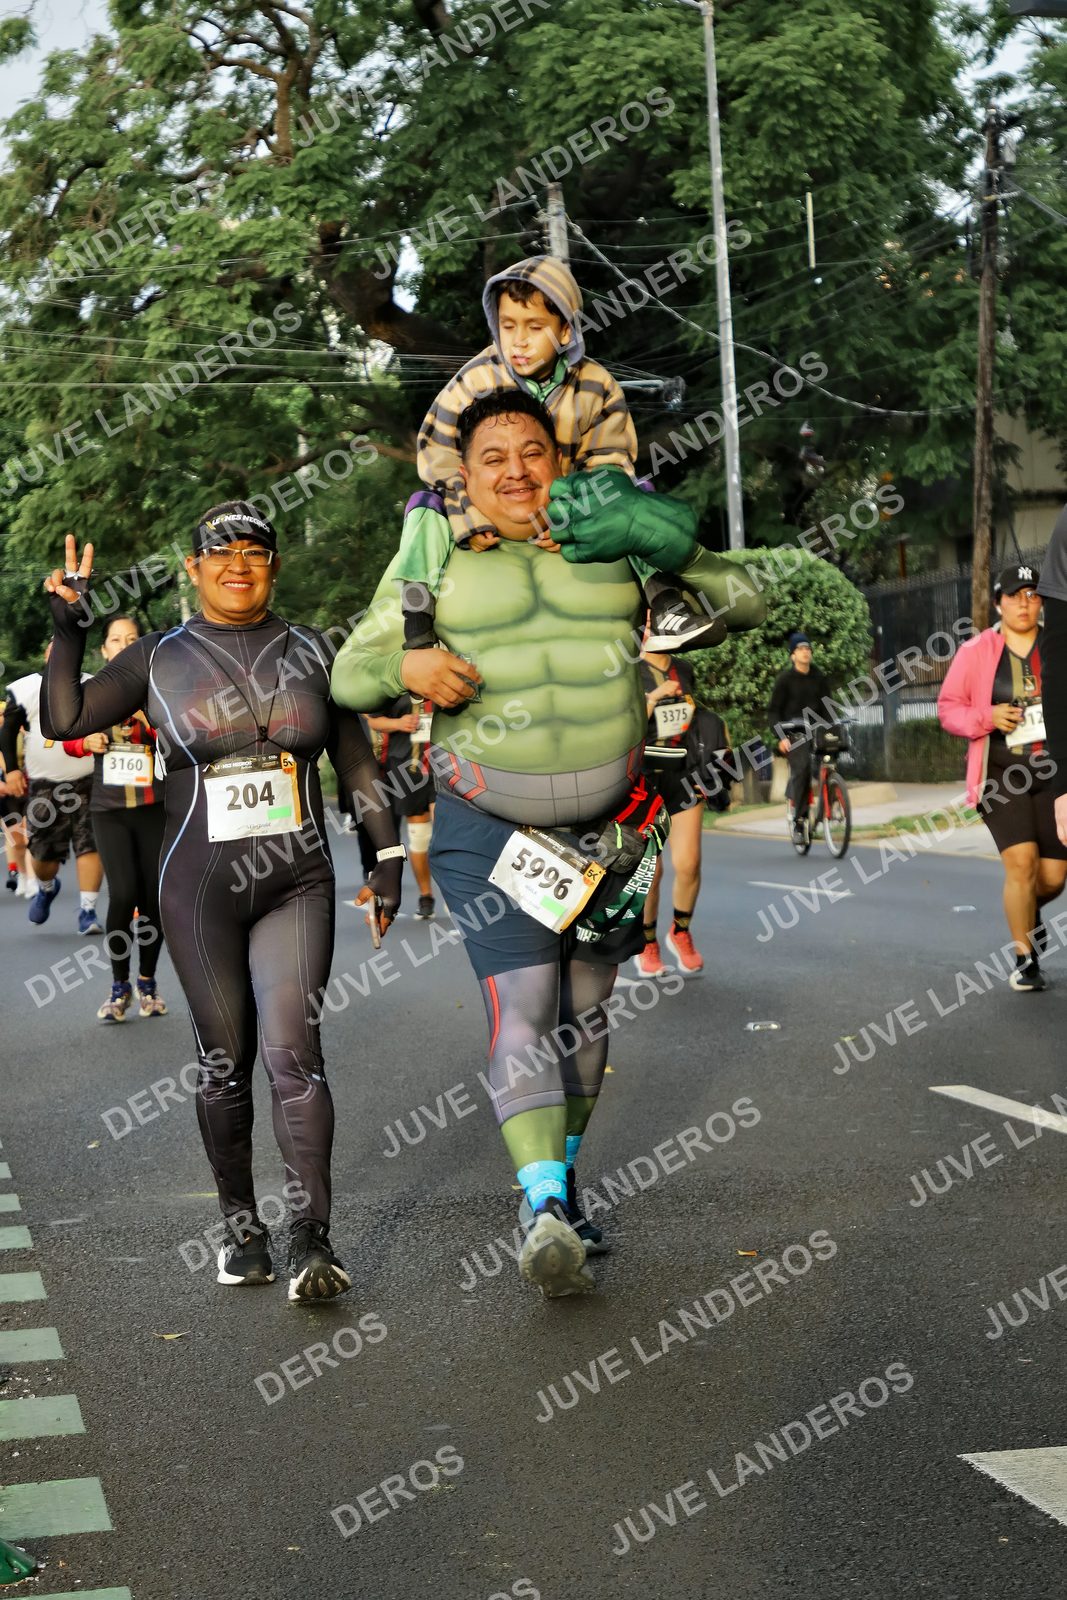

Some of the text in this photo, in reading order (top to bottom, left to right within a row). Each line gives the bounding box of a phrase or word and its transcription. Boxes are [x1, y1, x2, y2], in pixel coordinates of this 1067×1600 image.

[661, 707, 688, 723] 3375
[1019, 710, 1044, 728] 12
[109, 757, 144, 771] 3160
[225, 780, 276, 811] 204
[511, 847, 574, 901] 5996
[622, 857, 651, 895] MEXICO
[636, 855, 657, 895] MEXICO
